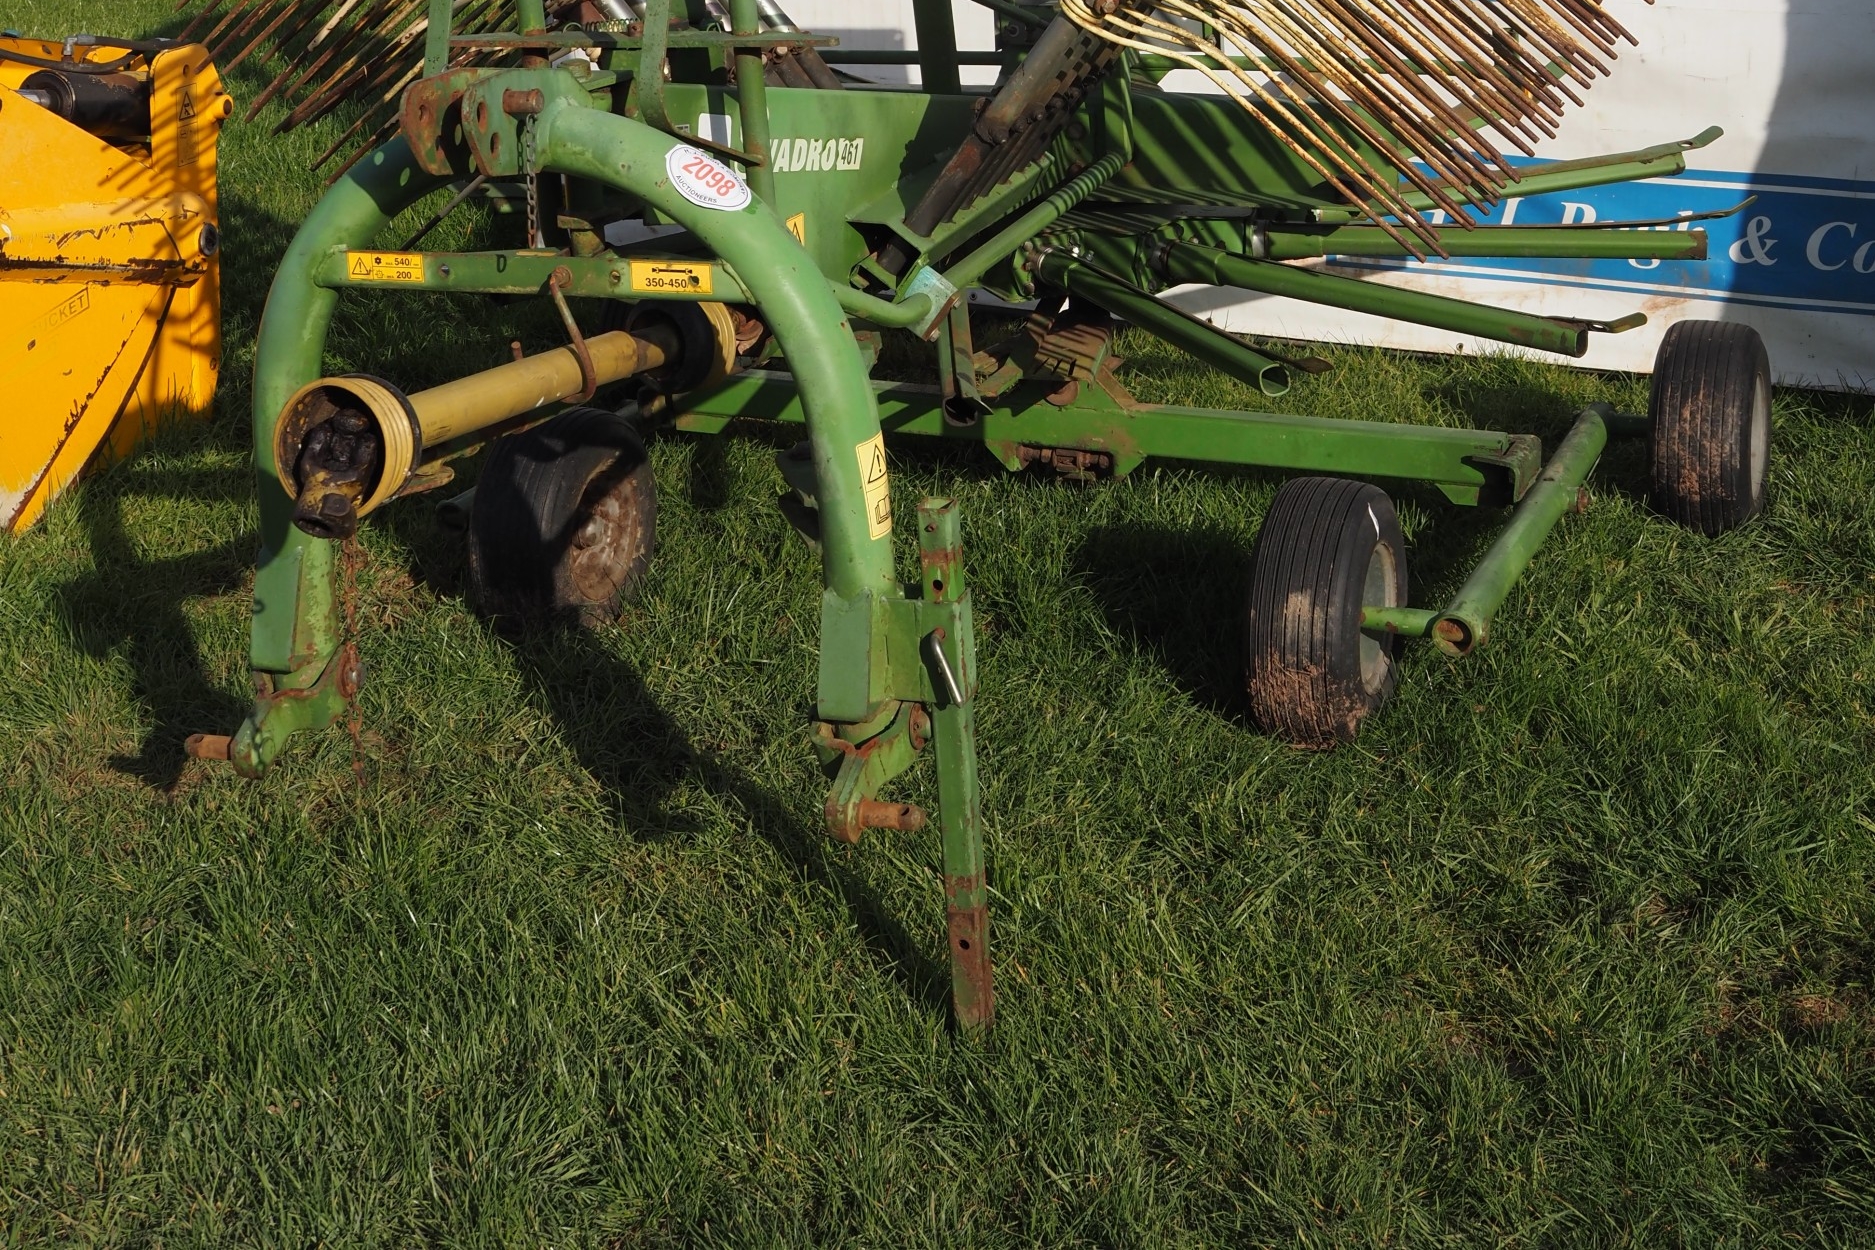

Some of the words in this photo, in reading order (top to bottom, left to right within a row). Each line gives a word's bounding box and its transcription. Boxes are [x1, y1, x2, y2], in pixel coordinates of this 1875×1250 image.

[840, 143, 859, 165] 461
[676, 175, 718, 203] AUCTIONEERS
[682, 156, 736, 197] 2098
[1728, 215, 1779, 266] &
[1806, 221, 1875, 274] Co
[396, 270, 412, 280] 200
